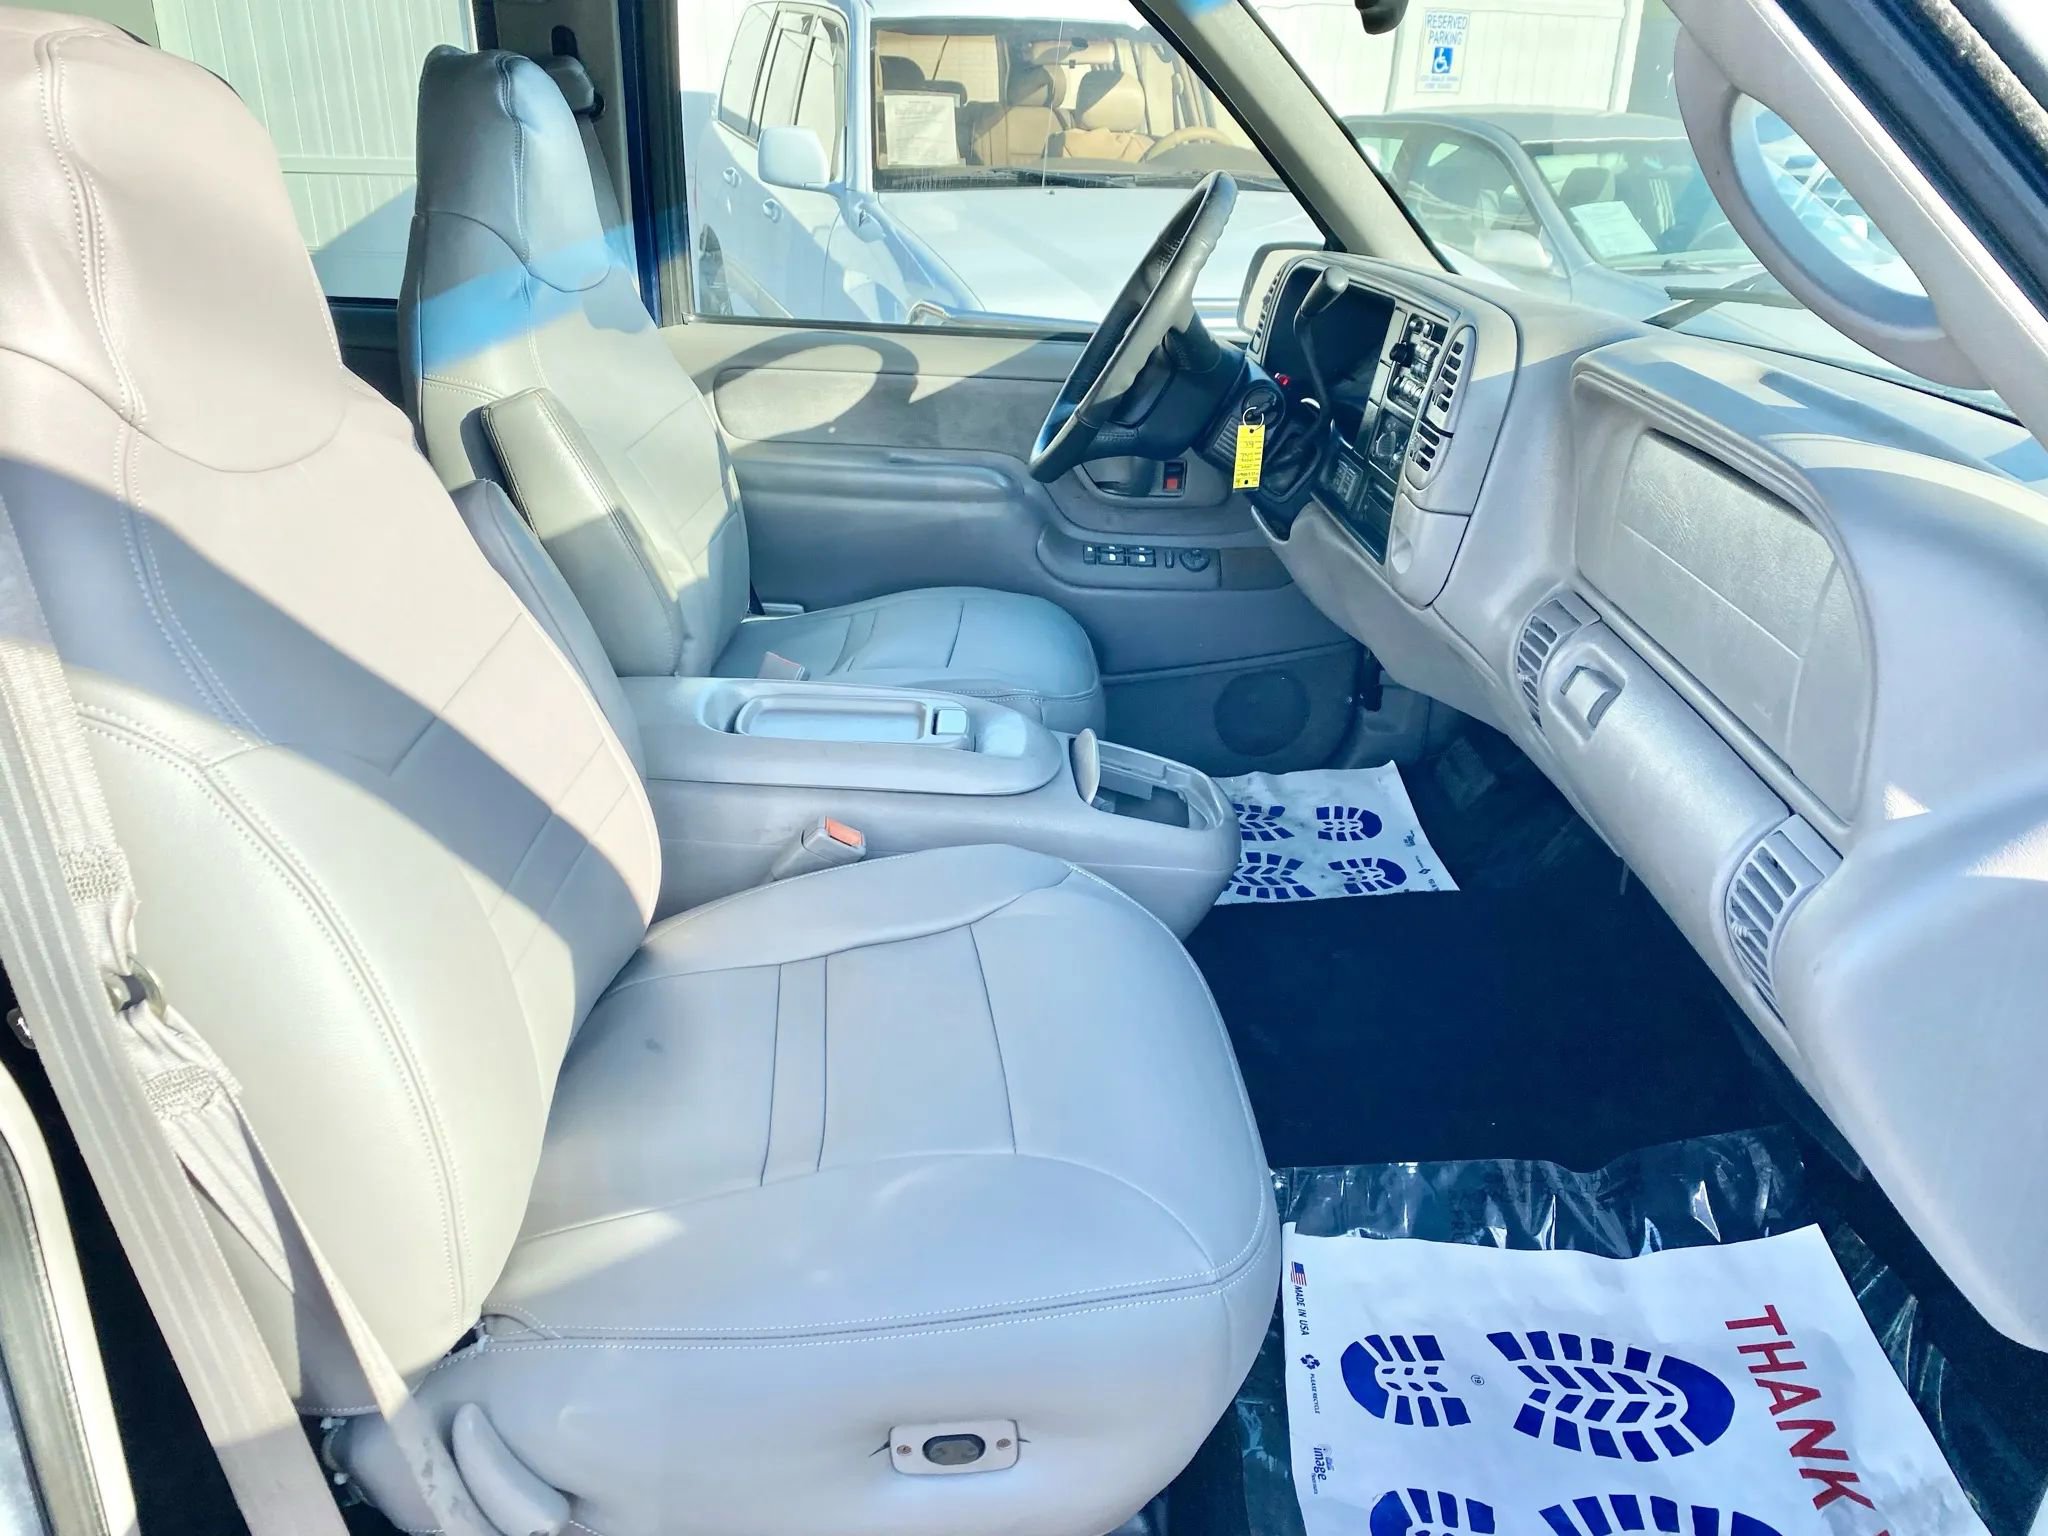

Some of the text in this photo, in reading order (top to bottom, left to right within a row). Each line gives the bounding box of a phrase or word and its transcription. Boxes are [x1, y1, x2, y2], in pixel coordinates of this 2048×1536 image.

[1427, 14, 1467, 30] RESERVED
[1428, 31, 1463, 45] PARKING
[1294, 1285, 1310, 1336] MADE IN USA
[1725, 1304, 1877, 1511] THANK
[1313, 1447, 1327, 1481] image
